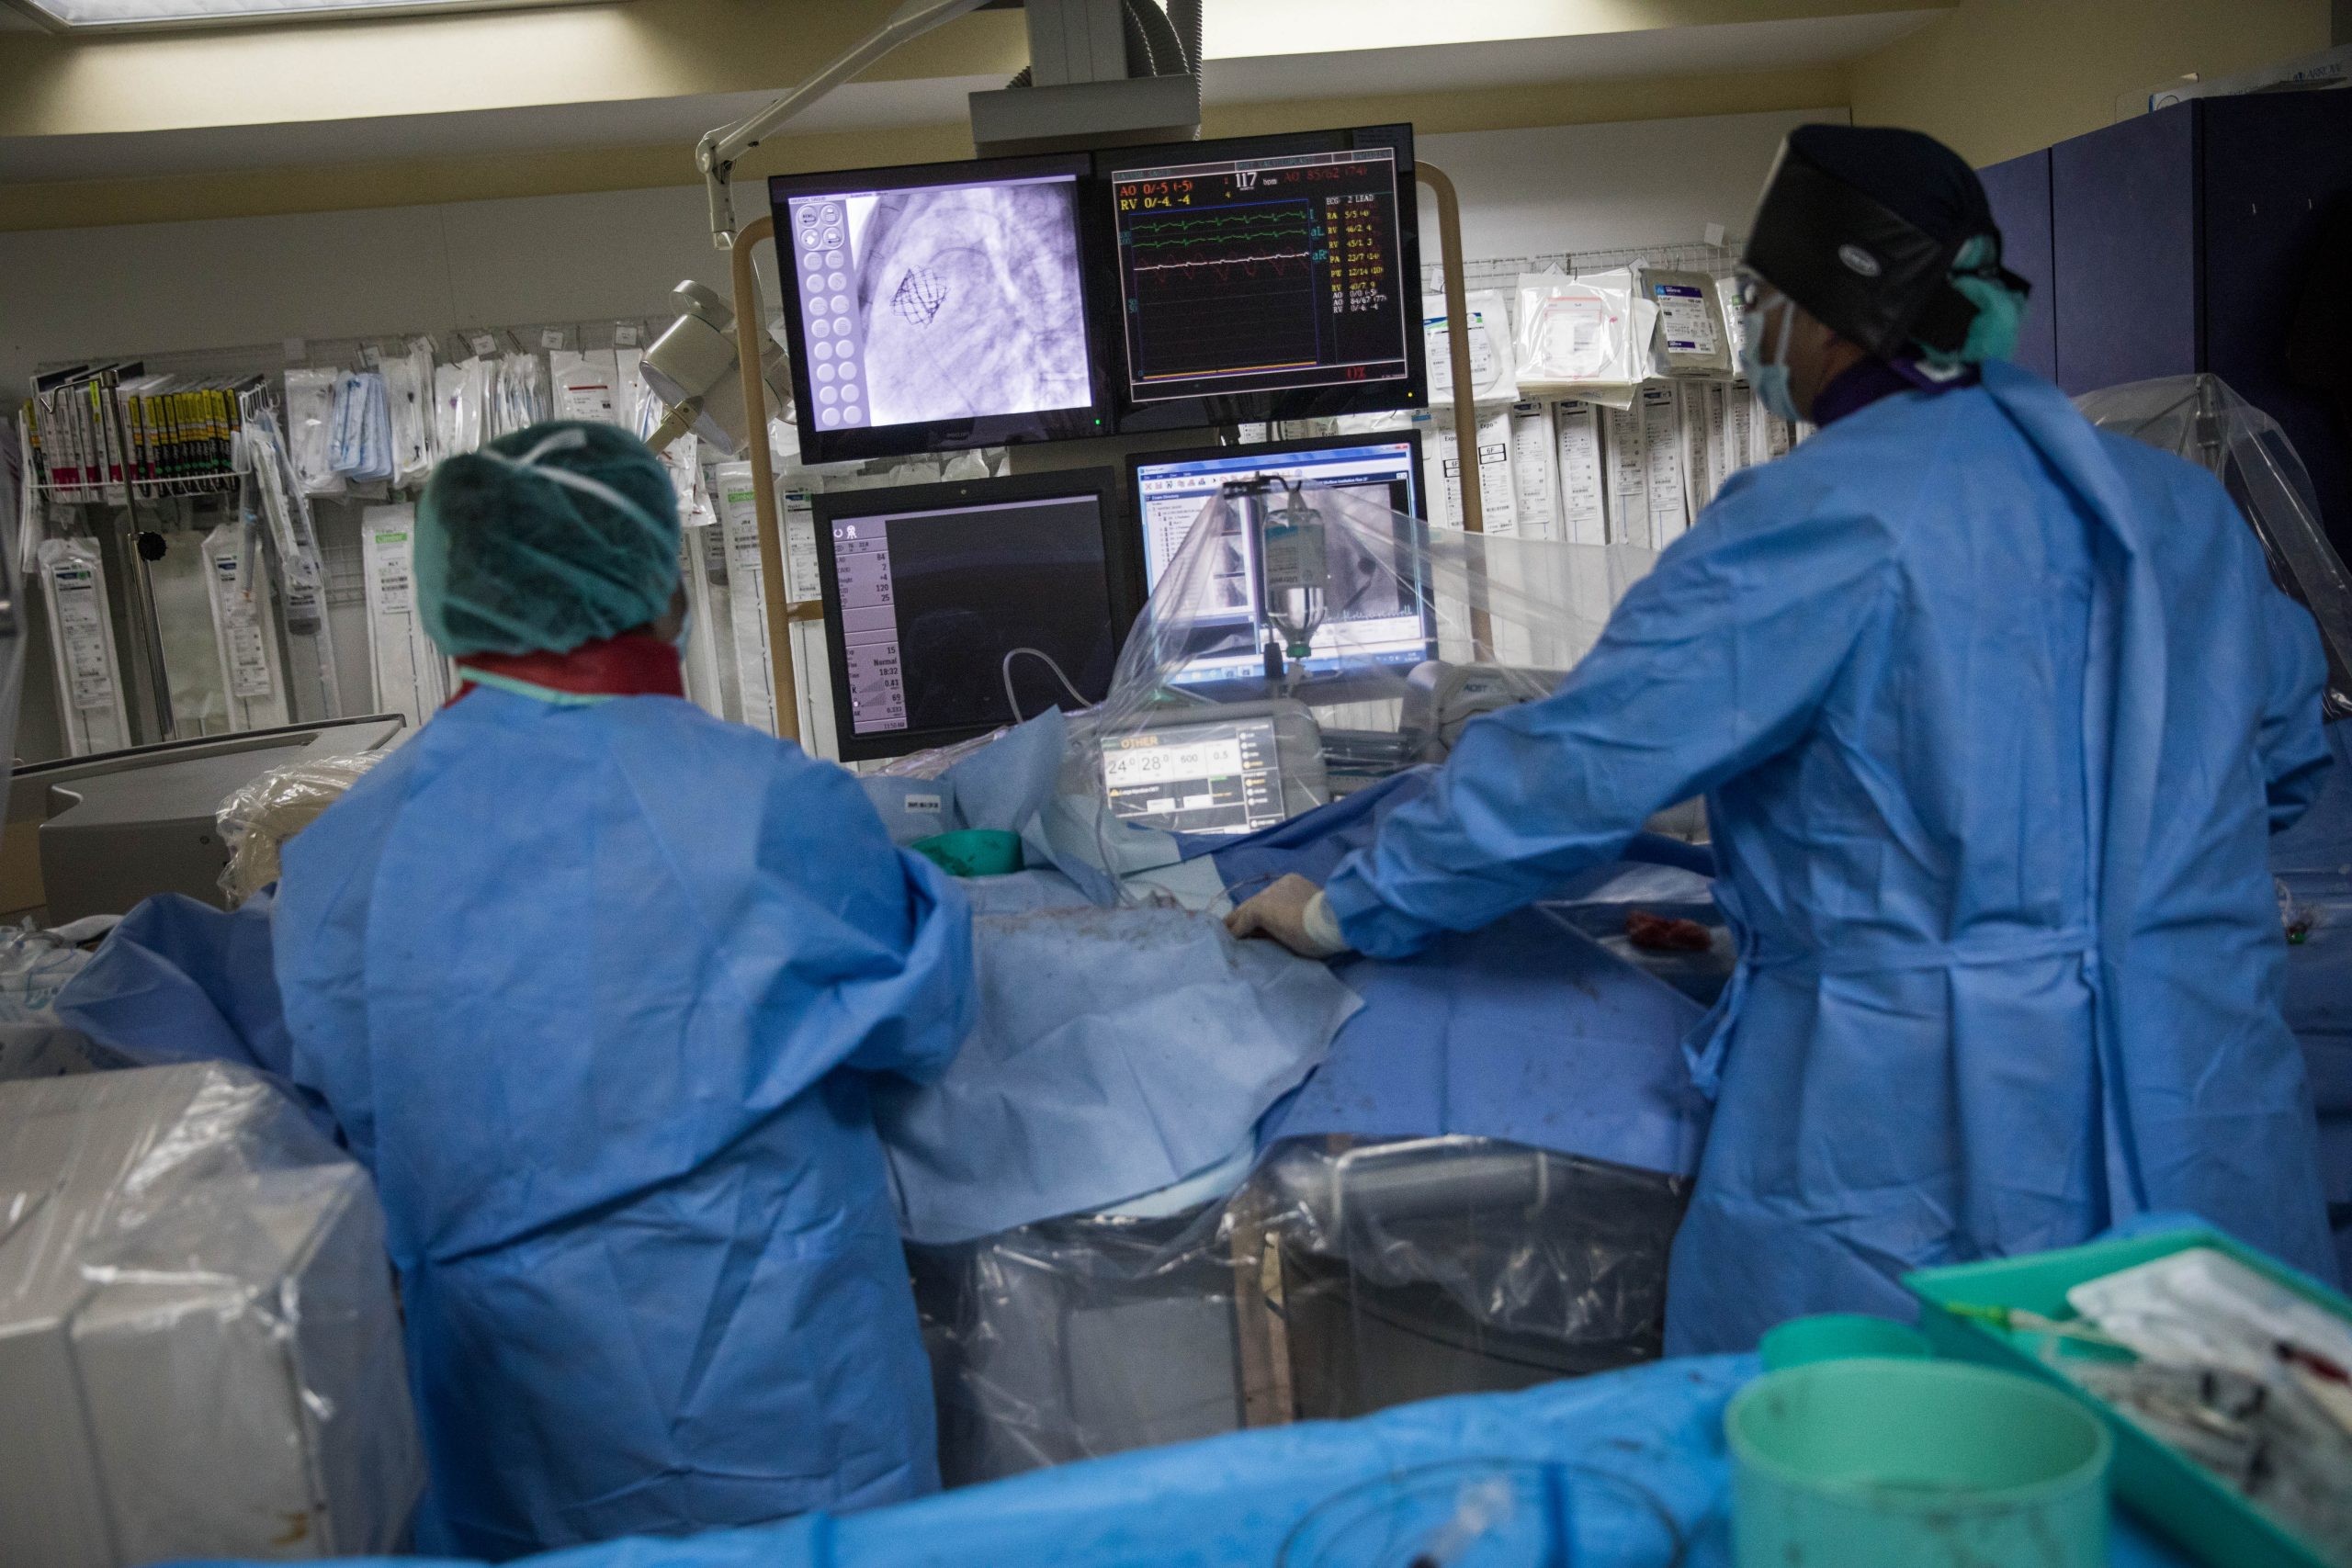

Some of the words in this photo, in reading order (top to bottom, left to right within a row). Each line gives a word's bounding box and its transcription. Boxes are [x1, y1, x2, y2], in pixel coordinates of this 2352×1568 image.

[1236, 172, 1258, 187] 117
[1120, 186, 1136, 196] AO
[1120, 198, 1137, 210] RV
[1177, 194, 1191, 205] -4
[1326, 197, 1339, 205] ECG
[1355, 194, 1374, 202] LEAD
[1329, 241, 1339, 249] RV
[876, 583, 889, 592] 120
[881, 593, 890, 602] 25
[888, 646, 896, 654] 15
[874, 658, 898, 666] Normal
[879, 667, 898, 676] 18:32
[1120, 736, 1159, 750] OTHER
[1213, 750, 1228, 761] 0.5
